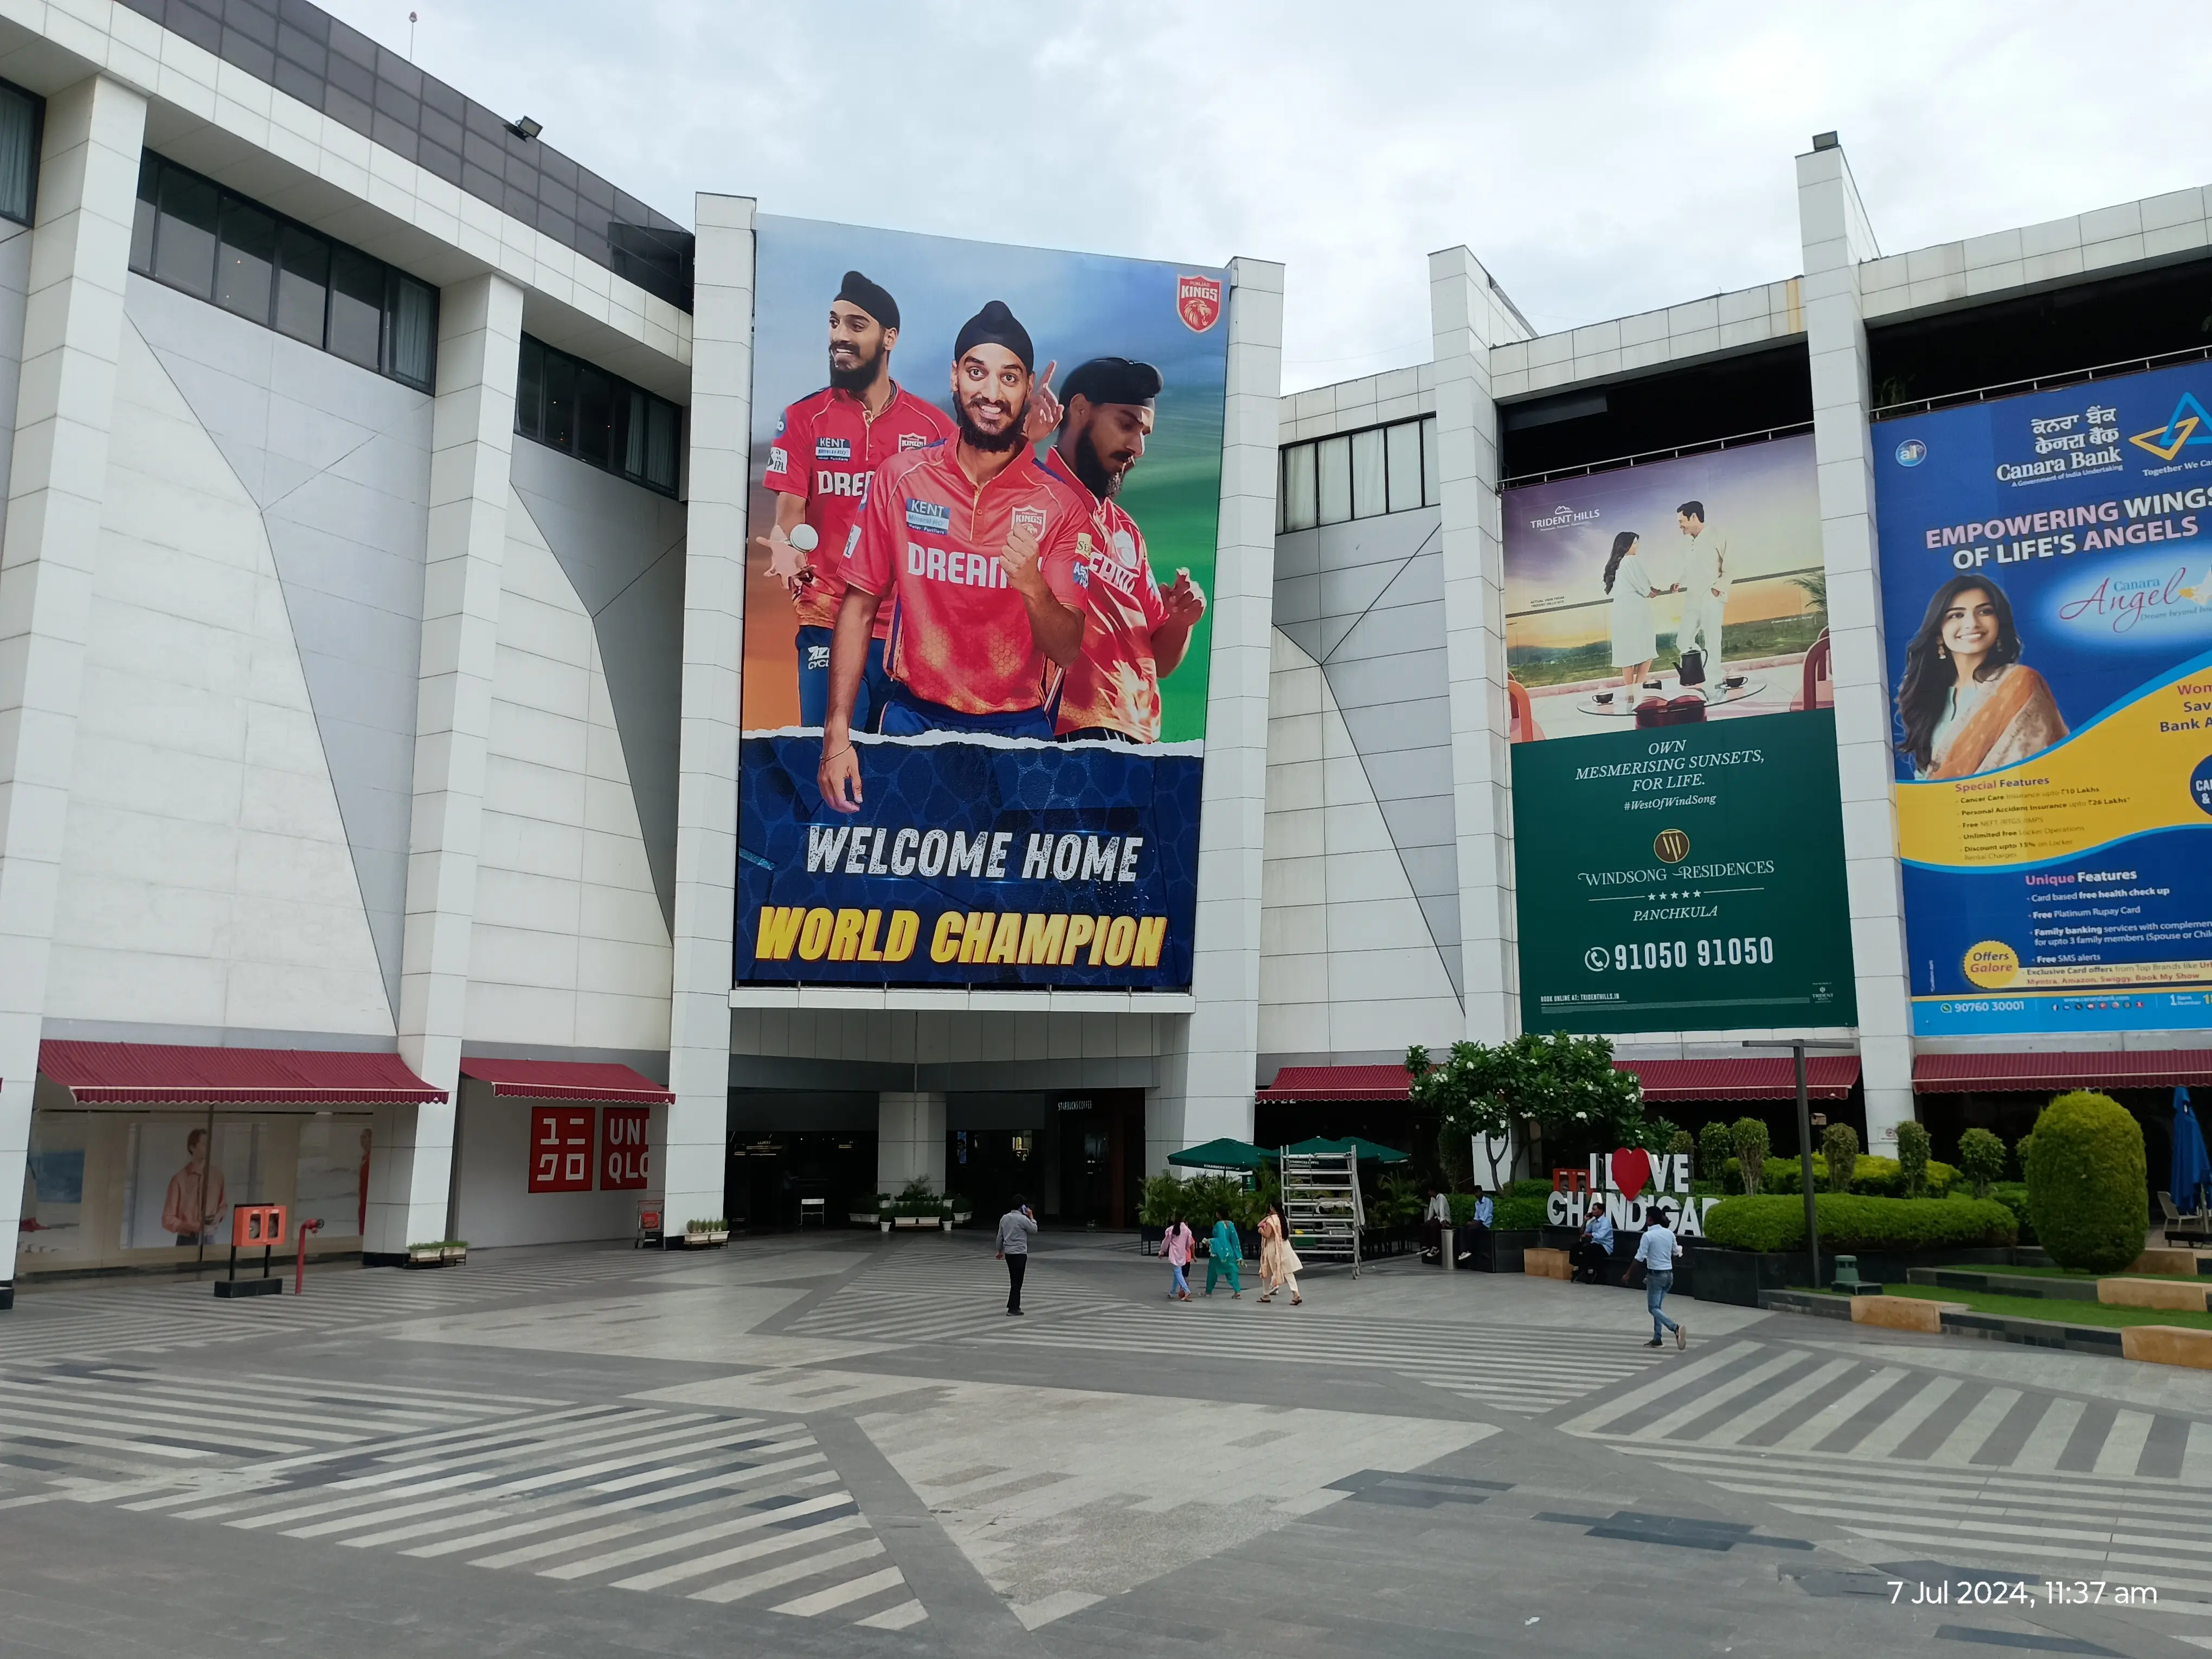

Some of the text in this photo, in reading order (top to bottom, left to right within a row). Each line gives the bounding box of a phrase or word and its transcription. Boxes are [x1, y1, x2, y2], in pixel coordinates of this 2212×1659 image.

[1181, 285, 1218, 303] KINGS
[2031, 405, 2116, 434] ਕੇਨਰਾ ਬੈਂਕ
[820, 437, 845, 448] KENT
[2035, 427, 2119, 454] केनरा बैंक
[1996, 446, 2123, 481] Canara Bank
[2143, 465, 2183, 477] Together
[2184, 461, 2198, 470] We
[2017, 475, 2056, 487] Government
[2065, 470, 2081, 480] India
[2082, 464, 2124, 476] Undertaking
[911, 499, 944, 518] KENT
[908, 514, 931, 524] Mineral
[1015, 515, 1043, 525] KINGS
[1530, 514, 1572, 529] TRIDENT
[1574, 509, 1600, 521] HILLS
[1926, 501, 2119, 549] EMPOWERING
[923, 526, 944, 535] Purifiers
[1953, 516, 2198, 569] OF LIFE'S ANGELS
[2114, 578, 2159, 592] Canara
[2060, 567, 2186, 633] Angel
[2169, 607, 2197, 616] beyond
[2183, 701, 2211, 712] Sav
[2160, 718, 2200, 732] Bank
[1648, 740, 1687, 755] OWN
[1575, 749, 1765, 781] MESMERISING SUNSETS,
[1631, 773, 1705, 792] FOR LIFE.
[1955, 777, 2049, 793] Special Features
[1624, 794, 1716, 811] #WestOfWindSong
[2202, 793, 2210, 804] &
[1963, 831, 2001, 839] Unlimited
[2044, 826, 2085, 834] Operations
[806, 825, 1143, 882] WELCOME HOME
[1964, 844, 1997, 852] Discount
[1578, 860, 1774, 886] WINDSONG RESIDENCES
[2025, 871, 2137, 886] Unique Features
[2031, 893, 2051, 902] Card
[2052, 892, 2077, 901] based
[2079, 891, 2097, 899] free
[2098, 889, 2127, 898] health
[2129, 887, 2156, 897] check
[1632, 906, 1718, 921] PANCHKULA
[2033, 905, 2141, 919] Free Platinum Rupay Card
[2034, 927, 2064, 937] Family
[2065, 925, 2102, 935] banking
[2104, 924, 2138, 933] services
[2138, 922, 2159, 931] with
[755, 907, 1167, 968] WORLD CHAMPION
[2034, 938, 2047, 947] for
[2048, 938, 2068, 947] upto
[2069, 937, 2075, 945] 3
[2076, 935, 2102, 945] family
[2104, 934, 2145, 943] members
[1615, 936, 1773, 971] 91050 91050
[1973, 951, 2009, 961] Offers
[2036, 953, 2101, 963] Free SMS alerts
[1970, 963, 2013, 973] Galore
[2153, 962, 2181, 970] Brands
[1954, 1001, 2024, 1012] 90760 30001
[1590, 1153, 1599, 1189] I
